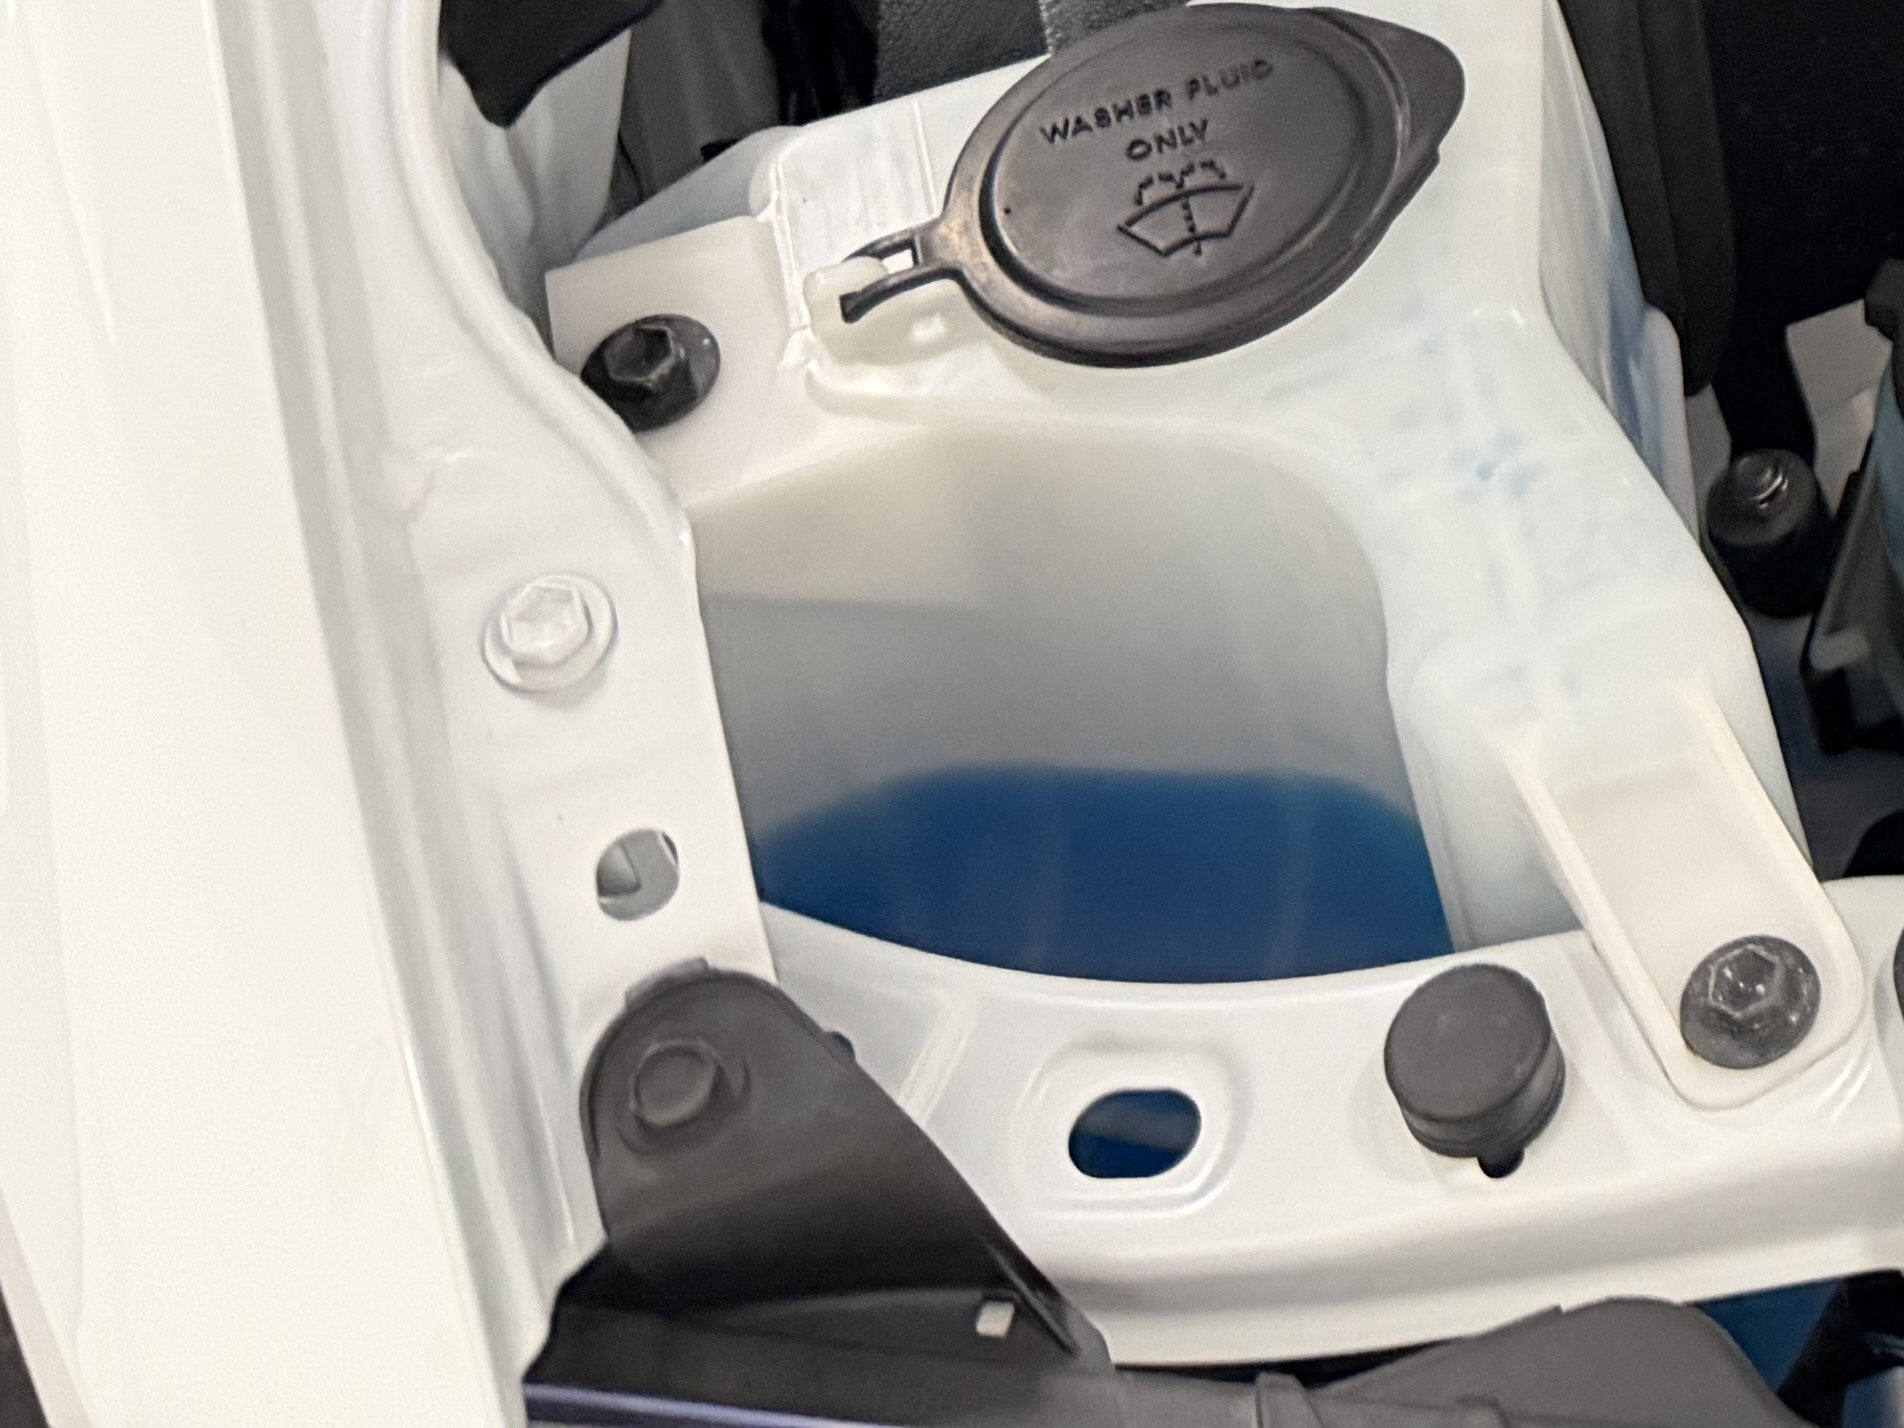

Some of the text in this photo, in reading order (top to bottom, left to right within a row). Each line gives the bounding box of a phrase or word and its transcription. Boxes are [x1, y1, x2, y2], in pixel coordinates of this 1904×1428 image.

[1040, 58, 1274, 144] WASHER FLUID
[1126, 118, 1208, 161] ONLY
